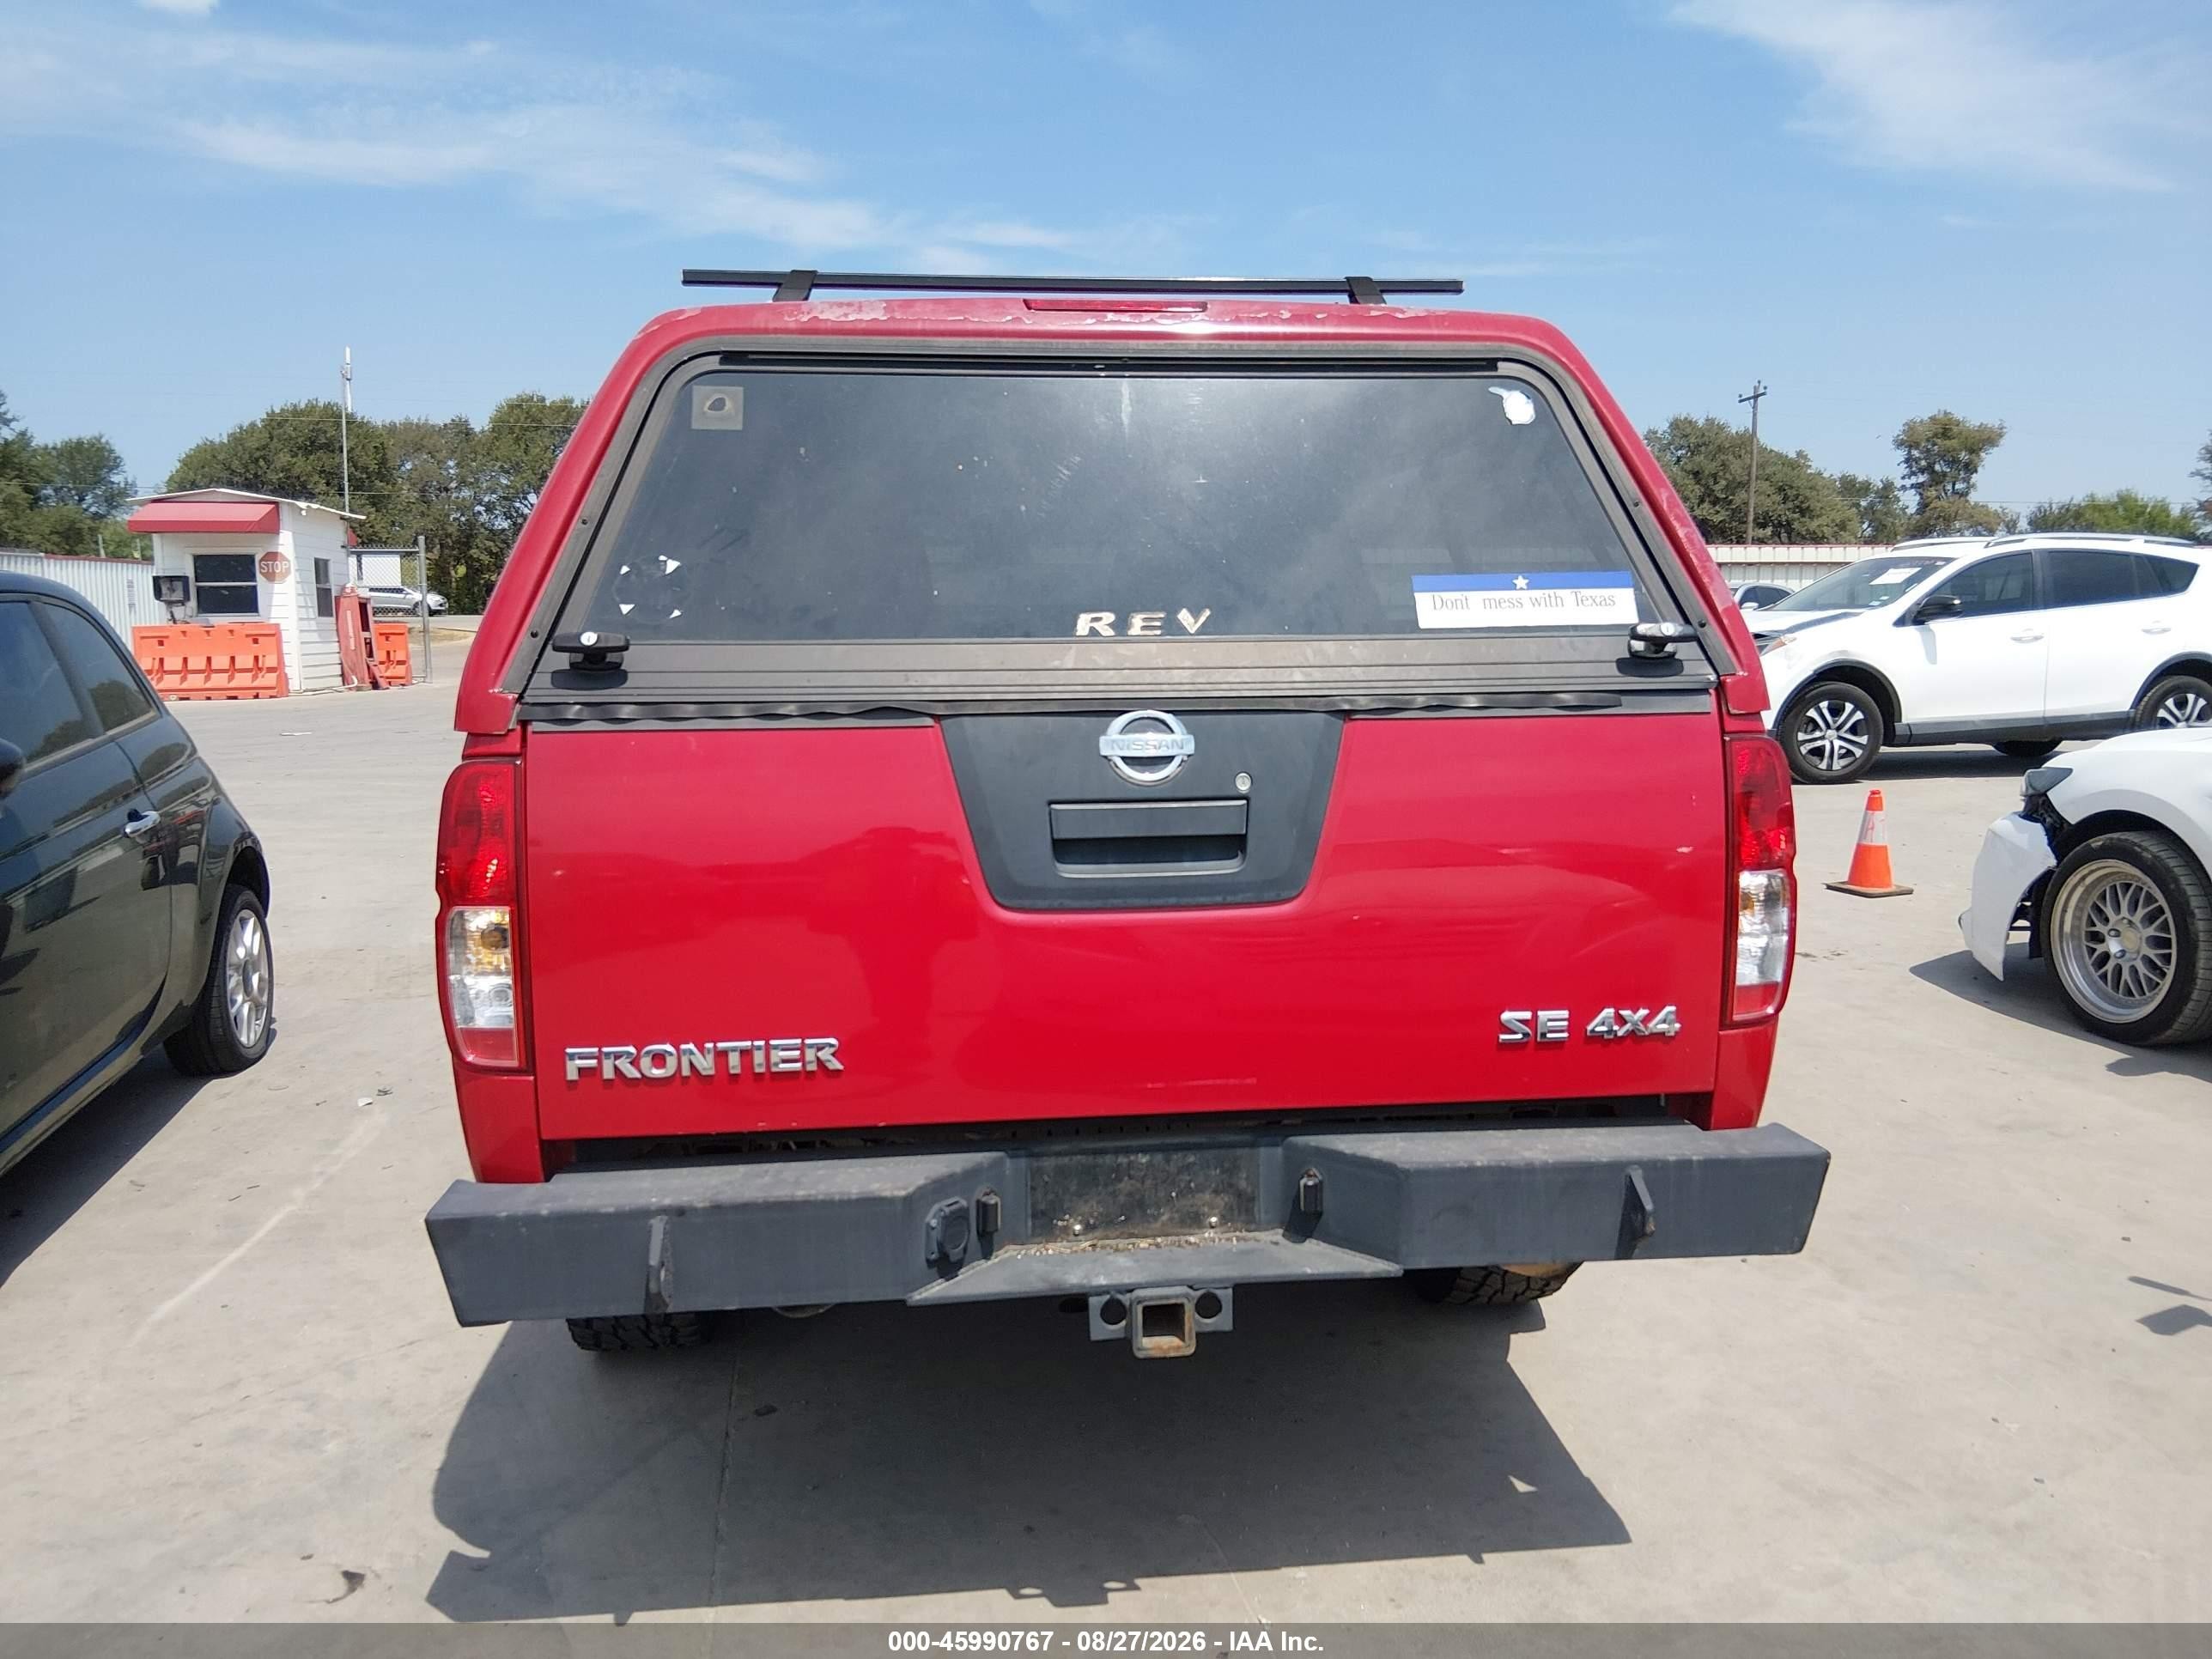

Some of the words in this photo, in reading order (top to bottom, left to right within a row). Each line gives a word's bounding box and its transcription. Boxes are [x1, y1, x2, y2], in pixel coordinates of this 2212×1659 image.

[260, 561, 289, 573] STOP
[1483, 597, 1524, 610] mess
[1529, 592, 1565, 608] with
[1571, 590, 1616, 607] Texas
[1111, 739, 1184, 750] NISSAN
[1498, 1009, 1570, 1043] SE
[564, 1036, 845, 1081] FRONTIER
